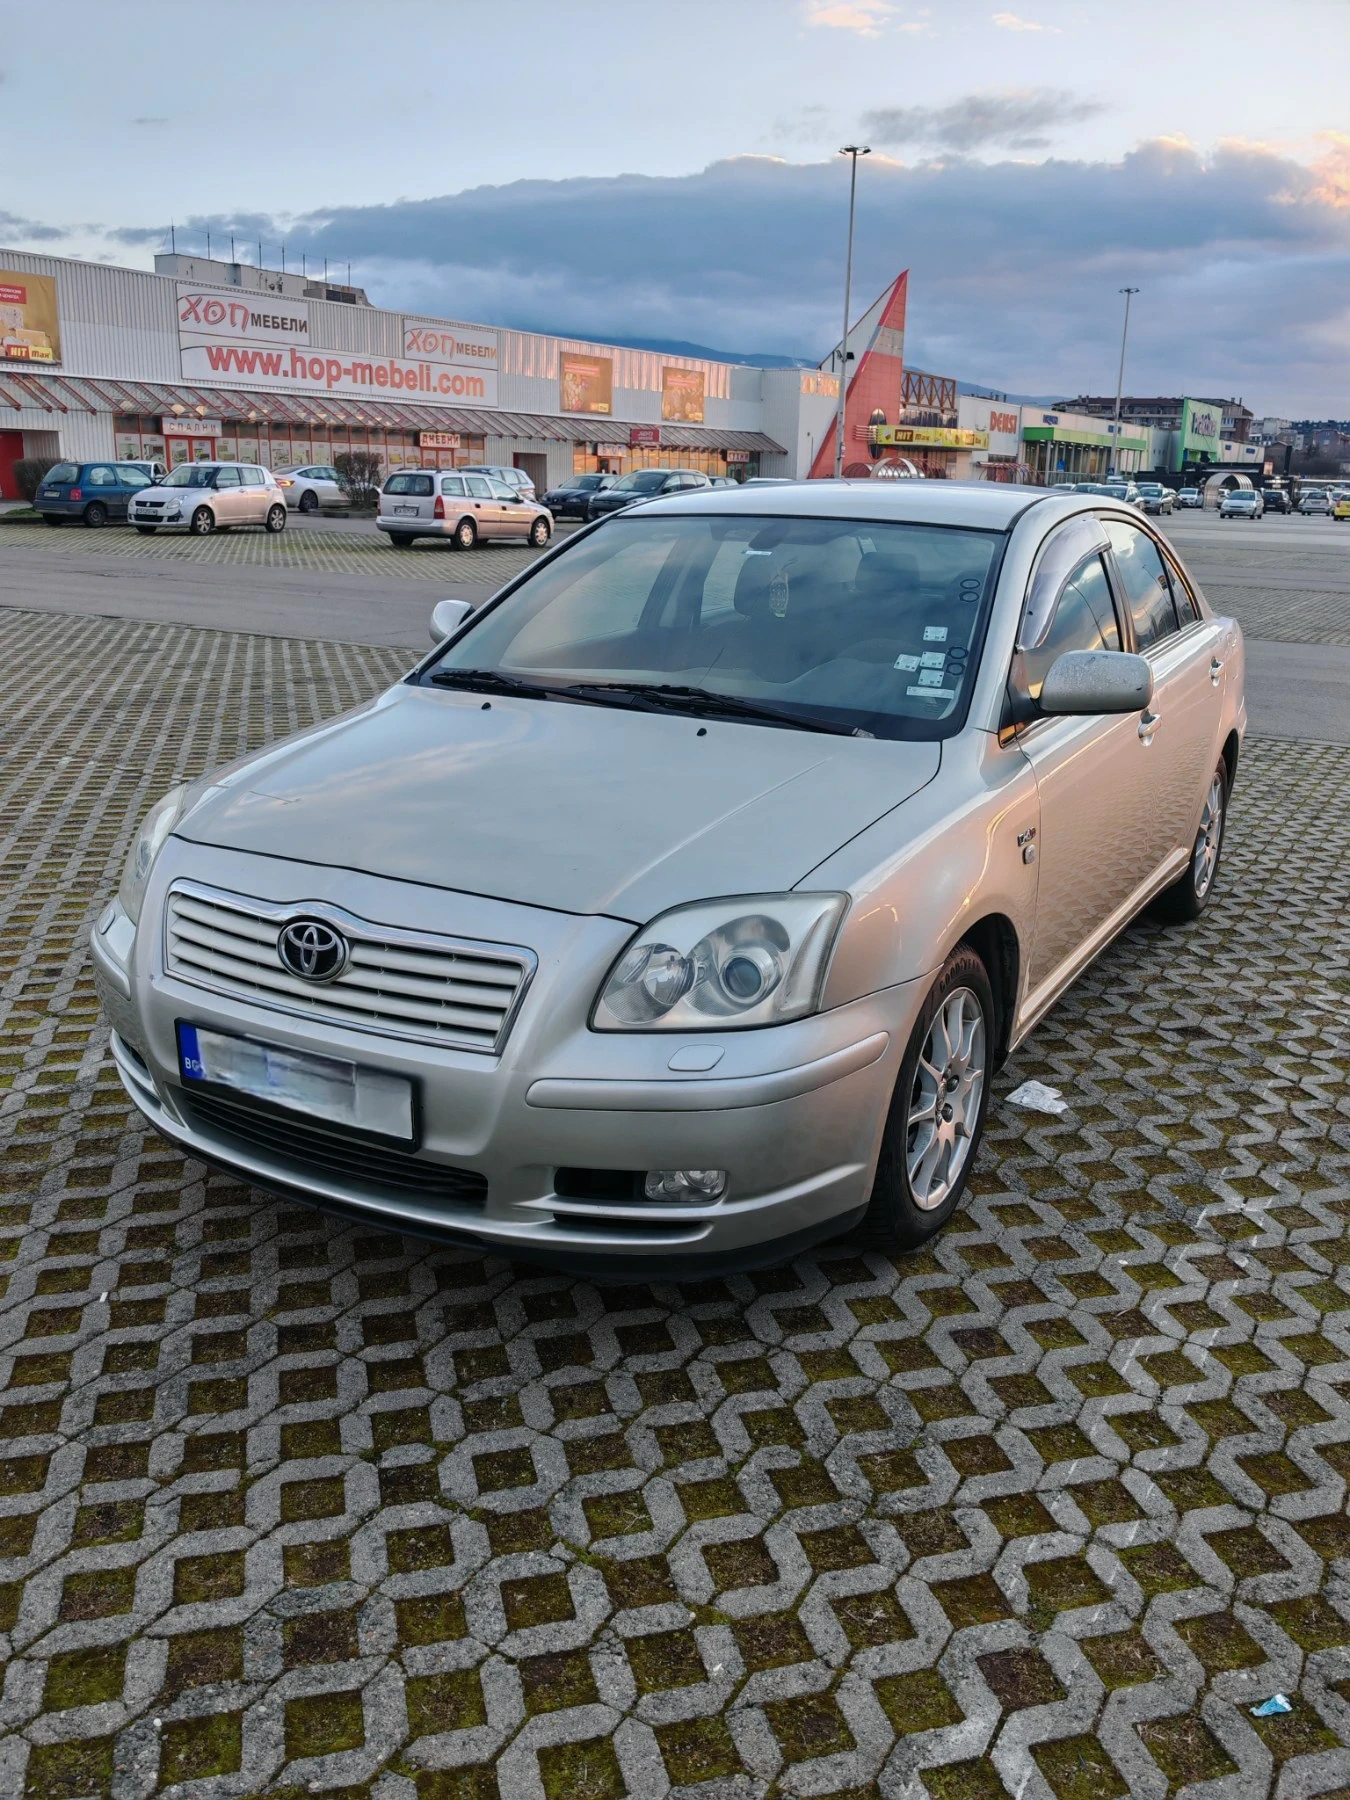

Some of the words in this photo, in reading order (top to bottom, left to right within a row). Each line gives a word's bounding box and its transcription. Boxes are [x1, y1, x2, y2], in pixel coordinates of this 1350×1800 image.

[180, 296, 250, 332] ХОП
[250, 313, 308, 333] МЕБЕЛИ
[407, 330, 456, 359] ХОП
[456, 343, 497, 359] МЕБЕЛИ
[10, 347, 27, 357] HIT
[206, 346, 484, 397] www.hop-mebeli.com
[169, 422, 216, 433] СПАЛНИ
[422, 434, 459, 446] ДНЕВНИ
[896, 431, 913, 440] HIT
